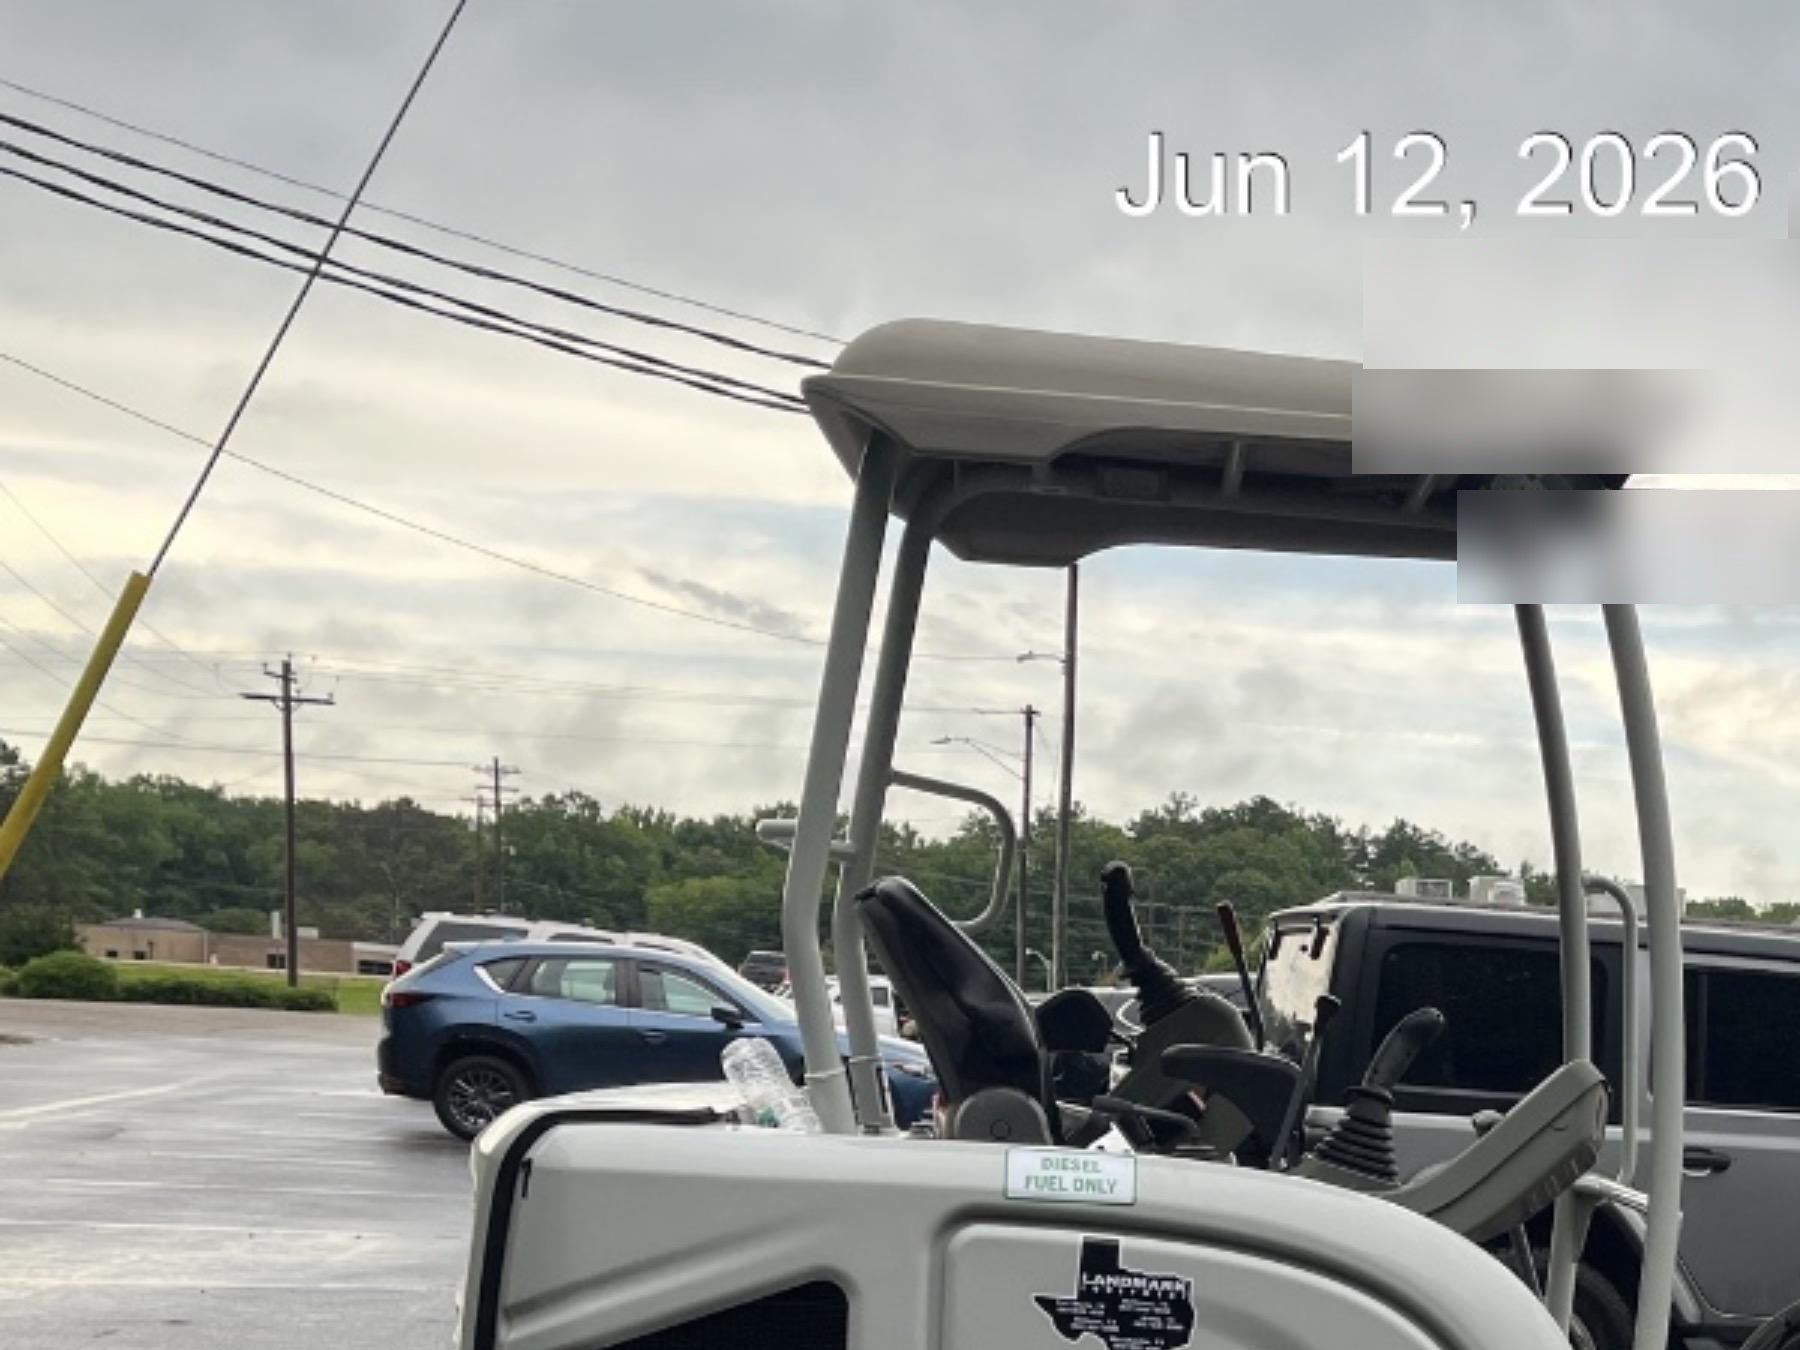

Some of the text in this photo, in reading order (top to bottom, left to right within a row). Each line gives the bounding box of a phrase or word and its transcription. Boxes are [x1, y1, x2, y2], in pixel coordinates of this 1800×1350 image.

[1040, 1156, 1103, 1174] DIESEL
[1024, 1174, 1118, 1195] FUEL ONLY
